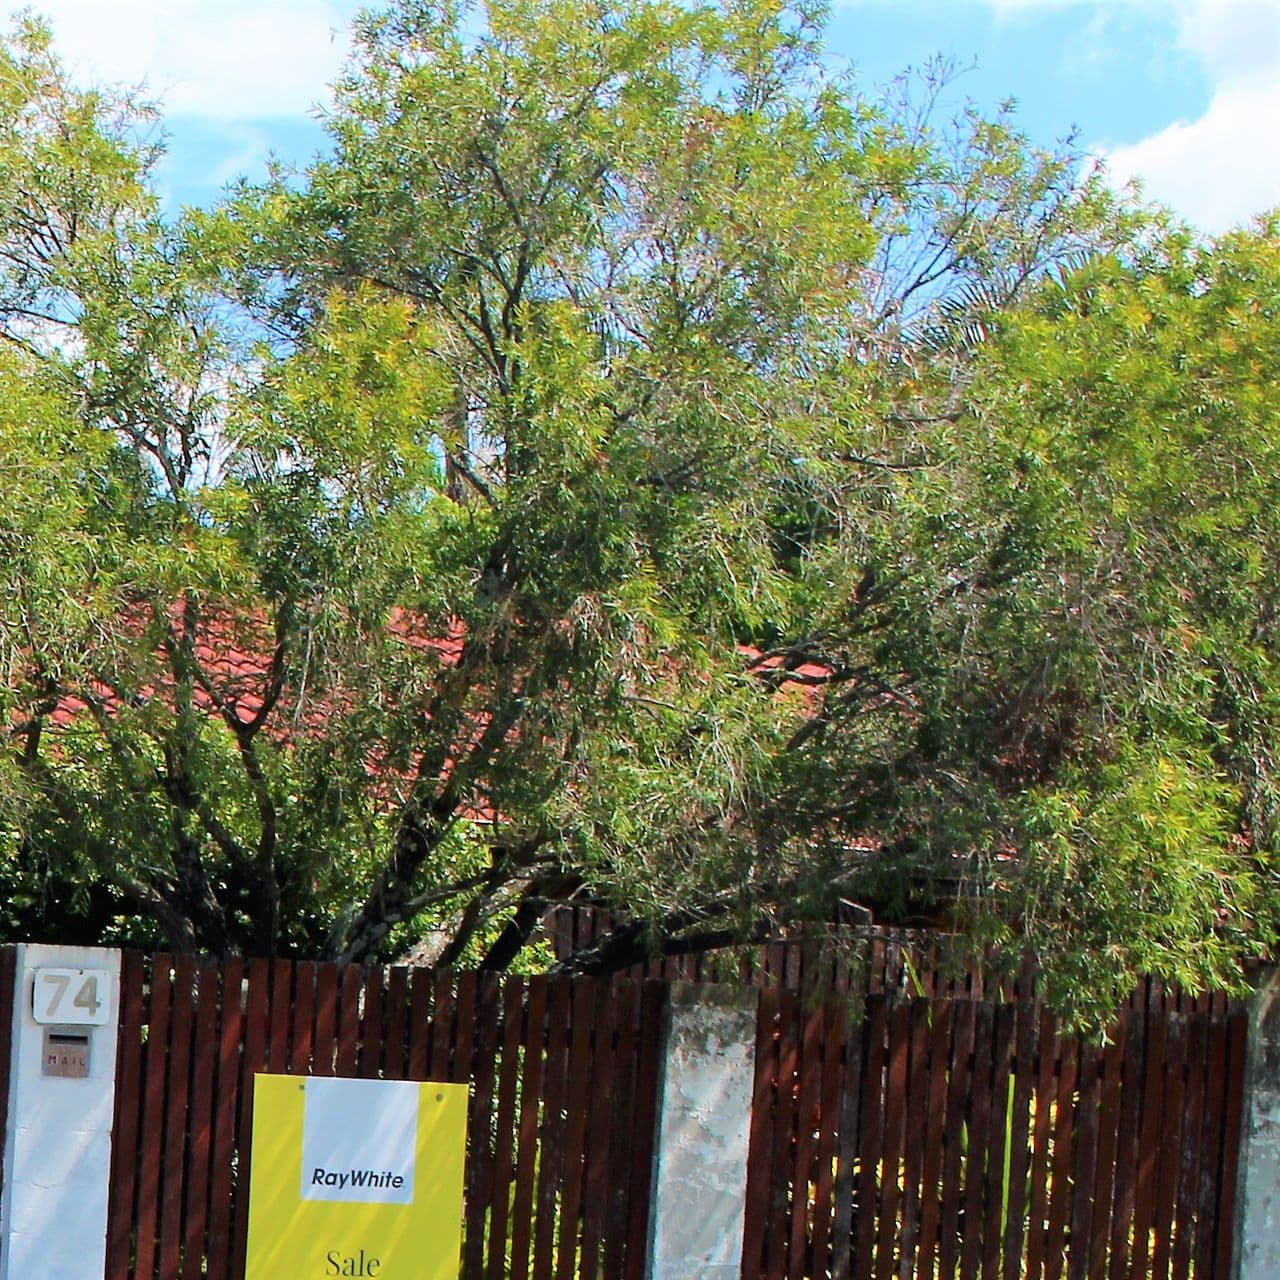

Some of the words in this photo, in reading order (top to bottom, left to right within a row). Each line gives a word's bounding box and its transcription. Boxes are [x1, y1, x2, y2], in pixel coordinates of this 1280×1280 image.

[42, 975, 102, 1017] 74
[47, 1055, 86, 1066] MAIL
[325, 1249, 381, 1278] Sale
